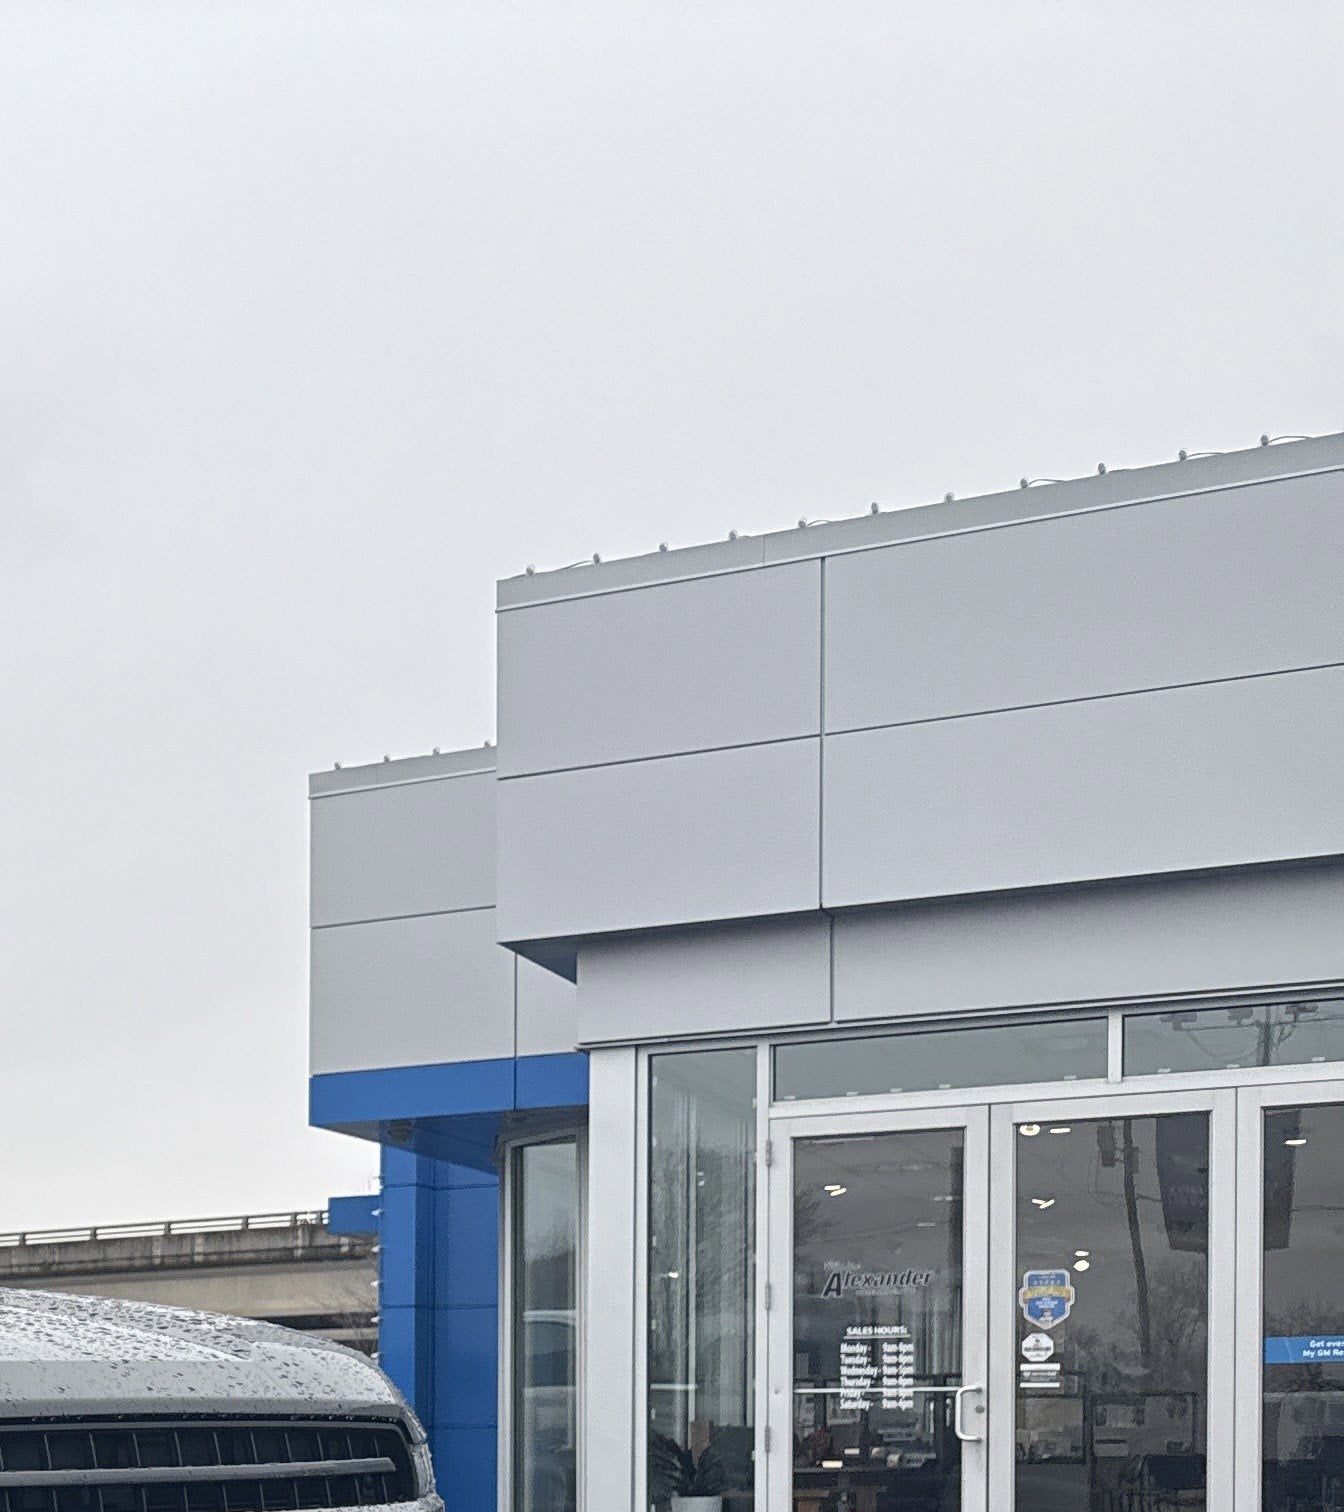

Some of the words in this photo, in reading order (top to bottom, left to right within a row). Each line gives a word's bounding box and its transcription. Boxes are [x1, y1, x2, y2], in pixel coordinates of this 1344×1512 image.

[821, 1268, 932, 1298] Alexander
[846, 1326, 873, 1335] SALES
[1302, 1349, 1315, 1359] My
